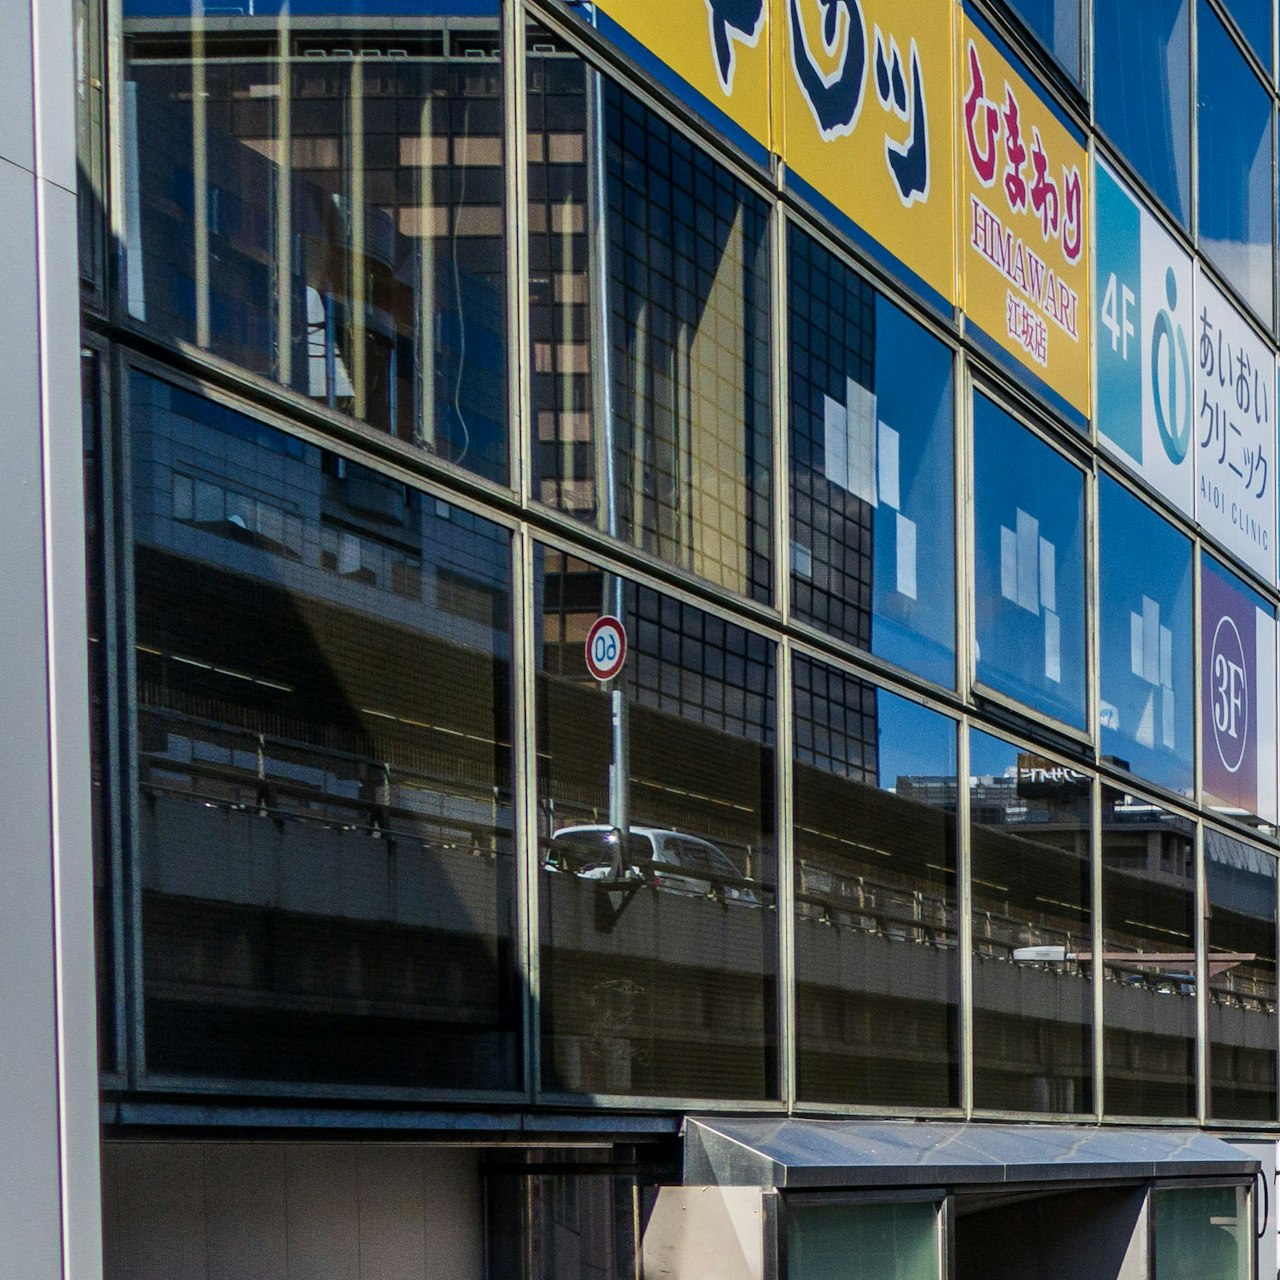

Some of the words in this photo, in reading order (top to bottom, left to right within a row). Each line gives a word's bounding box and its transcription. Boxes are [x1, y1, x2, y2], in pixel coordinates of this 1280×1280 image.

[970, 195, 1079, 342] HIMAWARI
[1006, 290, 1048, 368] 江坂店
[1101, 273, 1135, 360] 4F
[1200, 307, 1268, 422] あいおい
[1200, 401, 1267, 501] クリニック
[1200, 476, 1225, 515] AIOI
[1231, 499, 1269, 551] CLINIC
[1214, 653, 1246, 739] 3F
